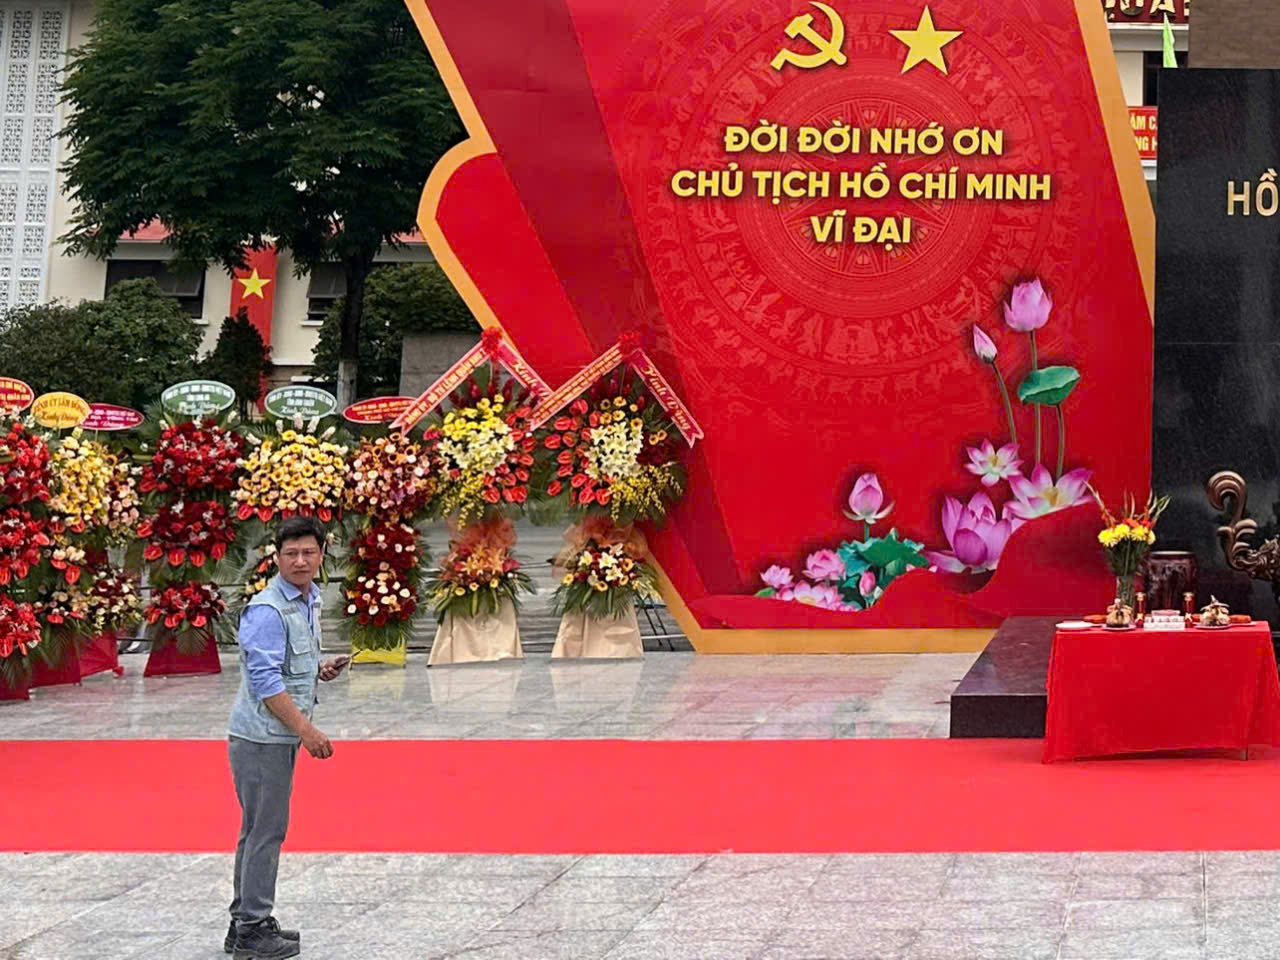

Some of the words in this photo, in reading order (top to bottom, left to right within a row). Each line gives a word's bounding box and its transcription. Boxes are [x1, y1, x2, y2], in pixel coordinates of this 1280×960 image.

[724, 119, 788, 153] ĐỜI
[797, 120, 860, 153] ĐỜI
[870, 121, 944, 155] NHỚ
[952, 126, 1003, 155] ƠN
[671, 162, 743, 197] CHỦ
[752, 170, 830, 205] TỊCH
[839, 162, 890, 198] HỒ
[899, 166, 959, 199] CHÍ
[966, 173, 1051, 200] MINH
[1227, 167, 1279, 217] HỒ
[810, 209, 847, 242] VĨ
[852, 217, 911, 251] ĐẠI
